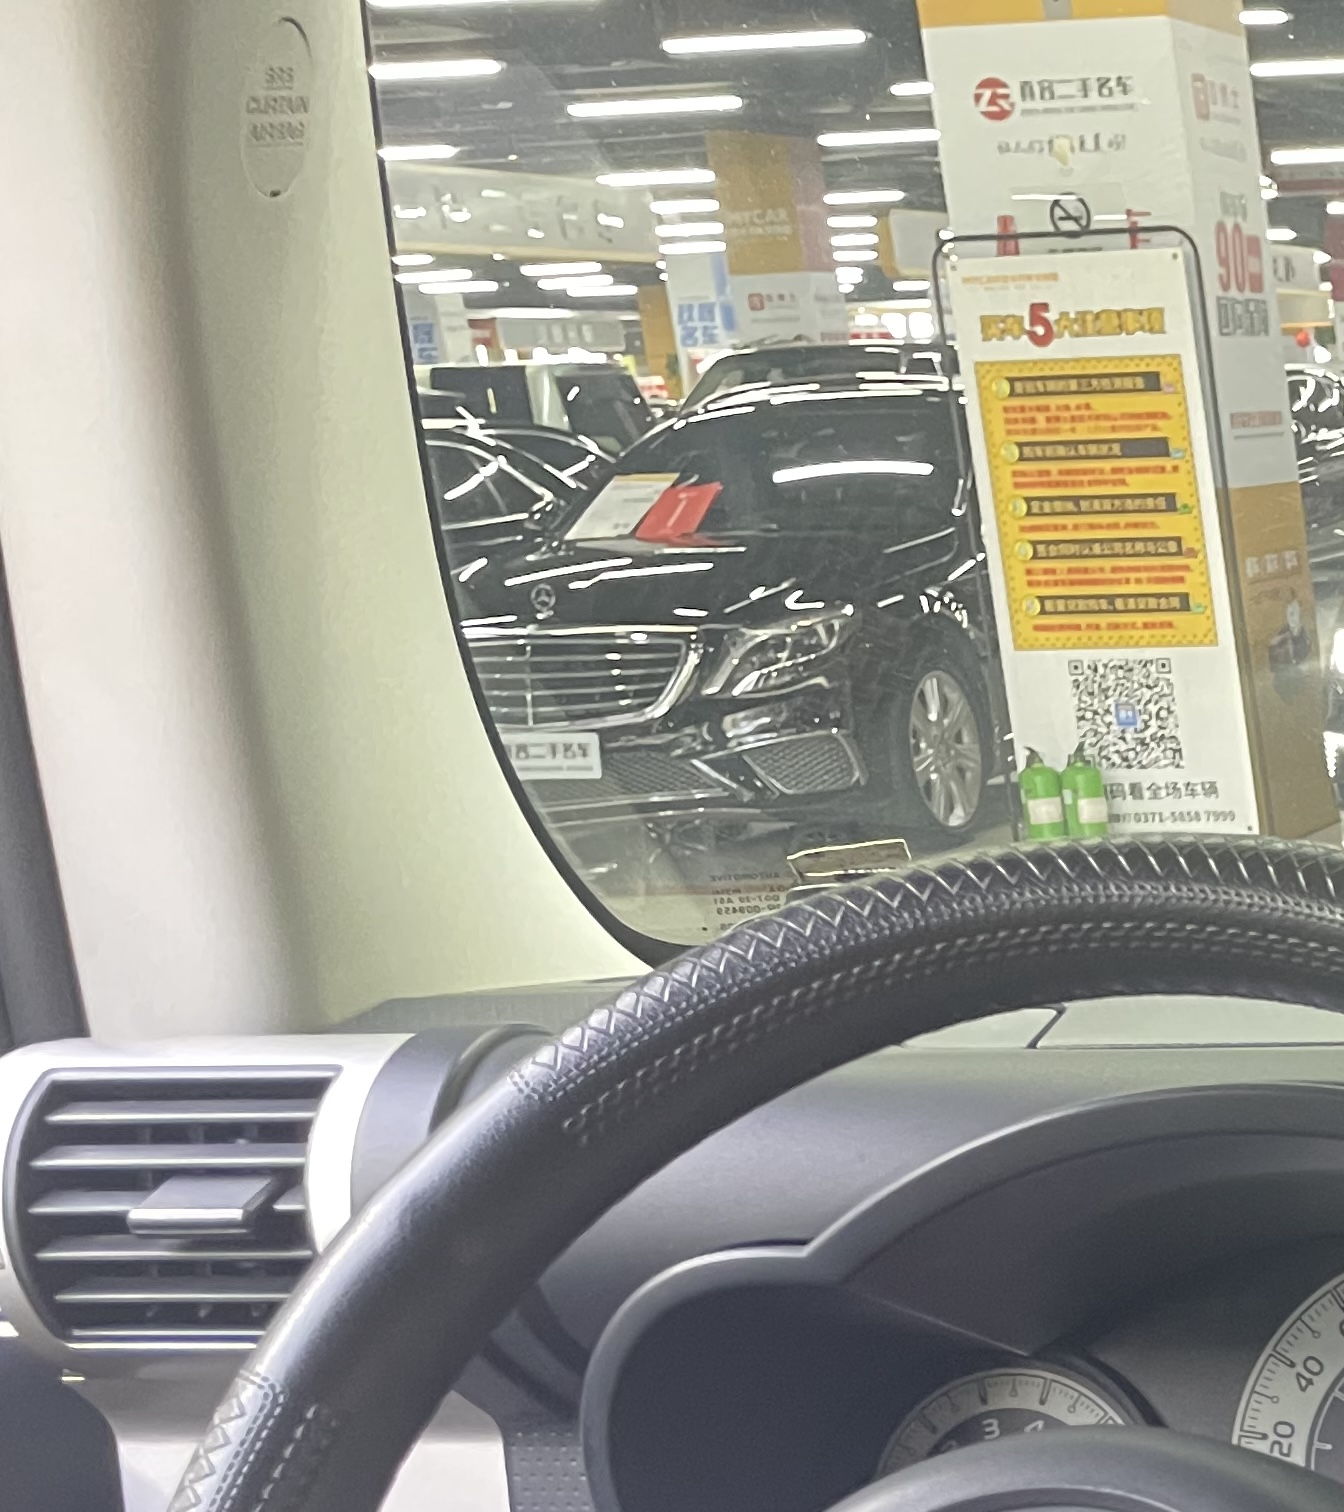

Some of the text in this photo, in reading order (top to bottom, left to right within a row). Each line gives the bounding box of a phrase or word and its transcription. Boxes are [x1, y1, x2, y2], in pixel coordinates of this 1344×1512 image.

[1295, 1356, 1324, 1393] 40
[982, 1418, 1000, 1439] 3
[1270, 1421, 1296, 1458] 20
